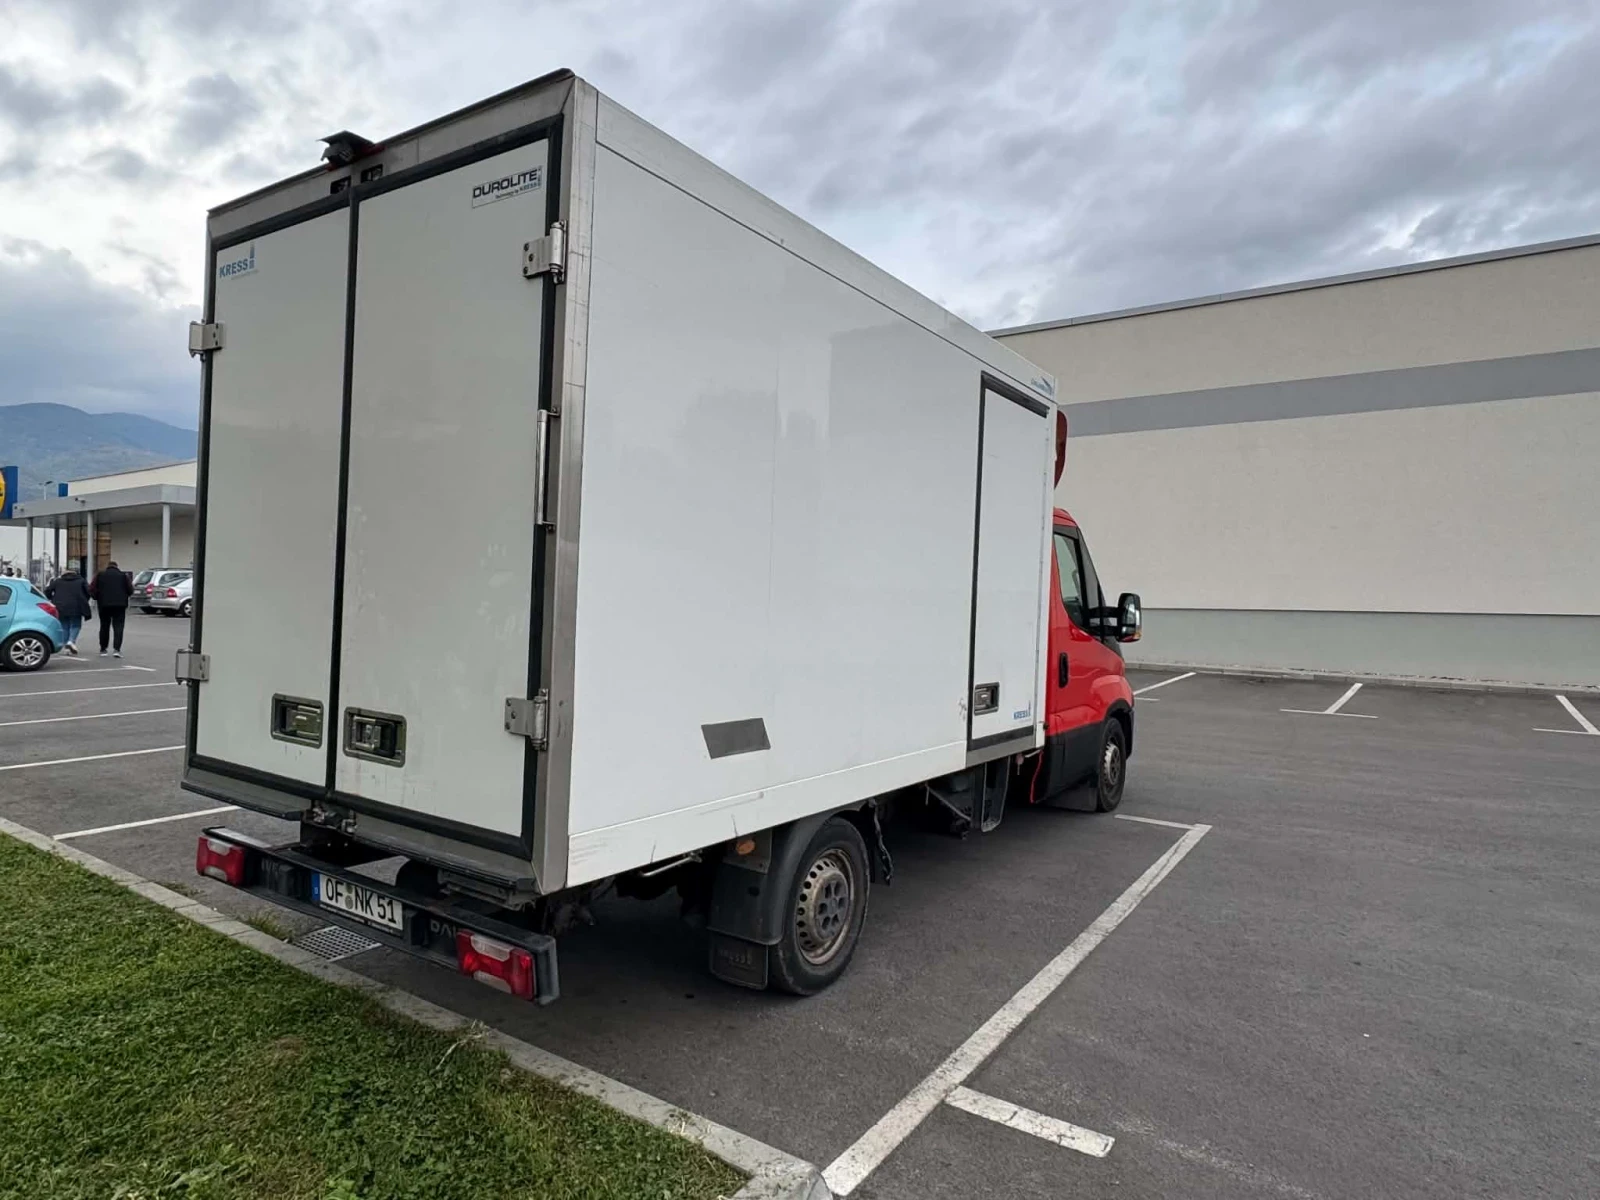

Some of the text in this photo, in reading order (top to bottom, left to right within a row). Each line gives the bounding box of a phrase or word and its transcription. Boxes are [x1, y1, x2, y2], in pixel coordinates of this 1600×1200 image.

[473, 168, 538, 198] DUROLITE
[219, 258, 248, 278] KRESS
[326, 878, 344, 904] OF
[355, 886, 374, 916] NK
[377, 896, 397, 924] 51
[430, 919, 457, 939] DAI
